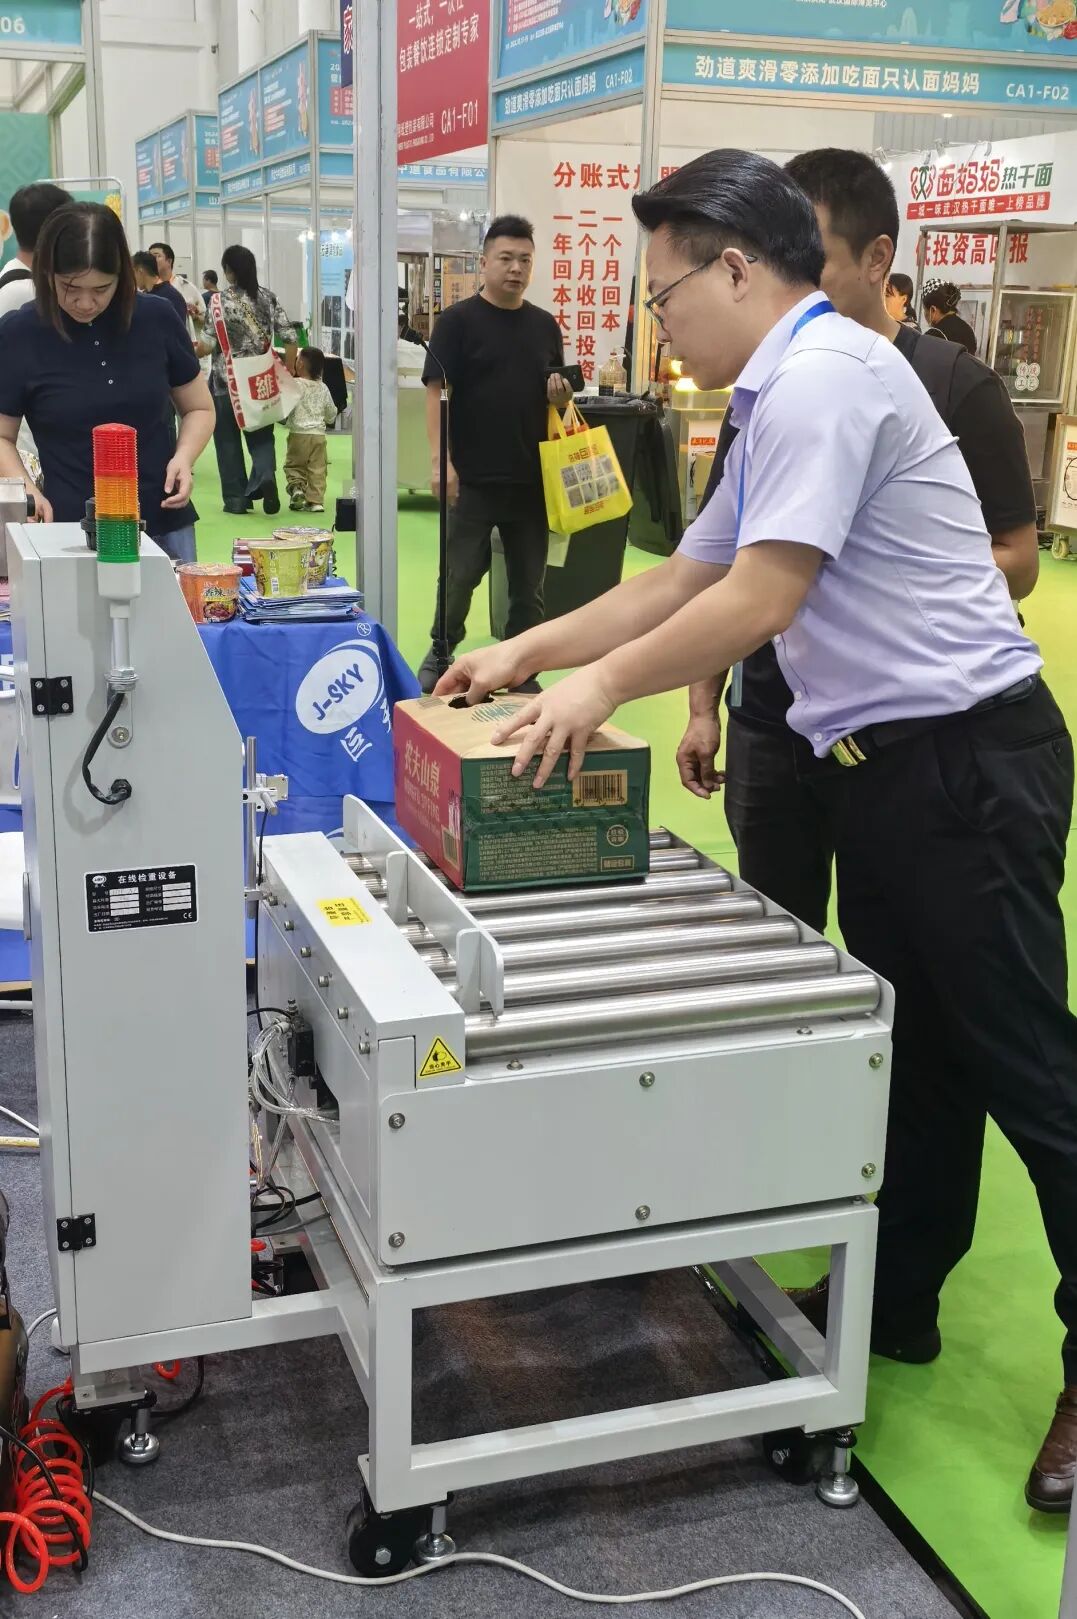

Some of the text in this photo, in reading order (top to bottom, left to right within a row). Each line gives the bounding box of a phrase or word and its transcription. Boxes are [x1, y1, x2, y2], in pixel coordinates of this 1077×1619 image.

[400, 13, 479, 72] 包装餐饮连锁定制专家
[504, 67, 634, 115] 劲道爽滑零添加吃面只认面妈妈 CA1-F02
[695, 54, 1070, 101] 劲道爽滑零添加吃面只认面妈妈 CA1-F02
[441, 99, 478, 135] CA1-F01
[1001, 162, 1054, 190] 热干面
[602, 217, 622, 331] 一个月回本
[312, 663, 365, 721] J-SKY
[404, 739, 441, 800] 农夫山泉
[118, 871, 176, 884] 在线检重设备
